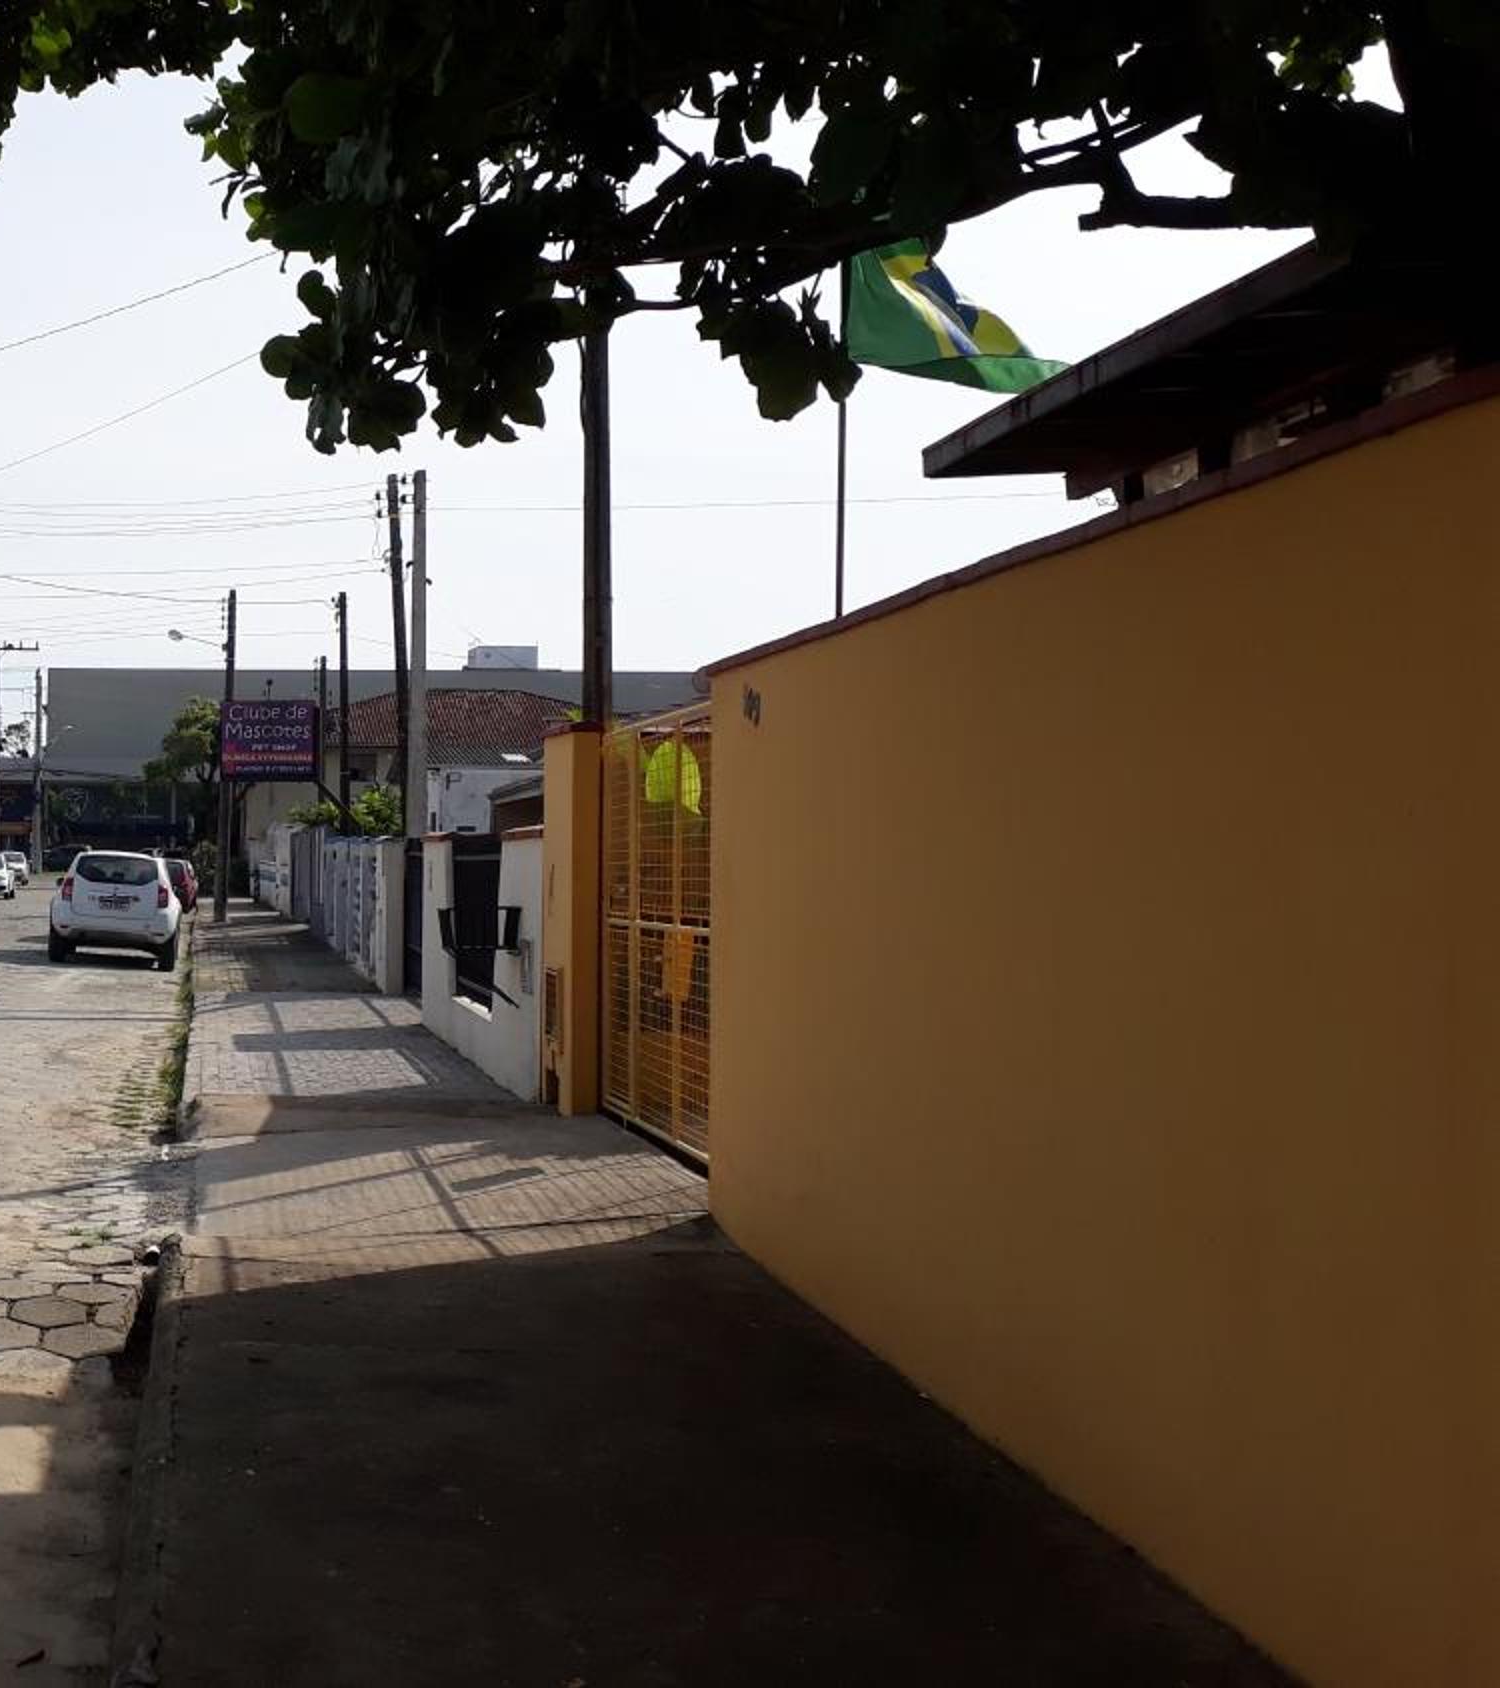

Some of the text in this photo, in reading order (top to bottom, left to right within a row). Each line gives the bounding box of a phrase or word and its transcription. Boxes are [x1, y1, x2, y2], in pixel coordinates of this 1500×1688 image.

[229, 704, 308, 721] Clube de
[225, 722, 310, 739] Mascotes
